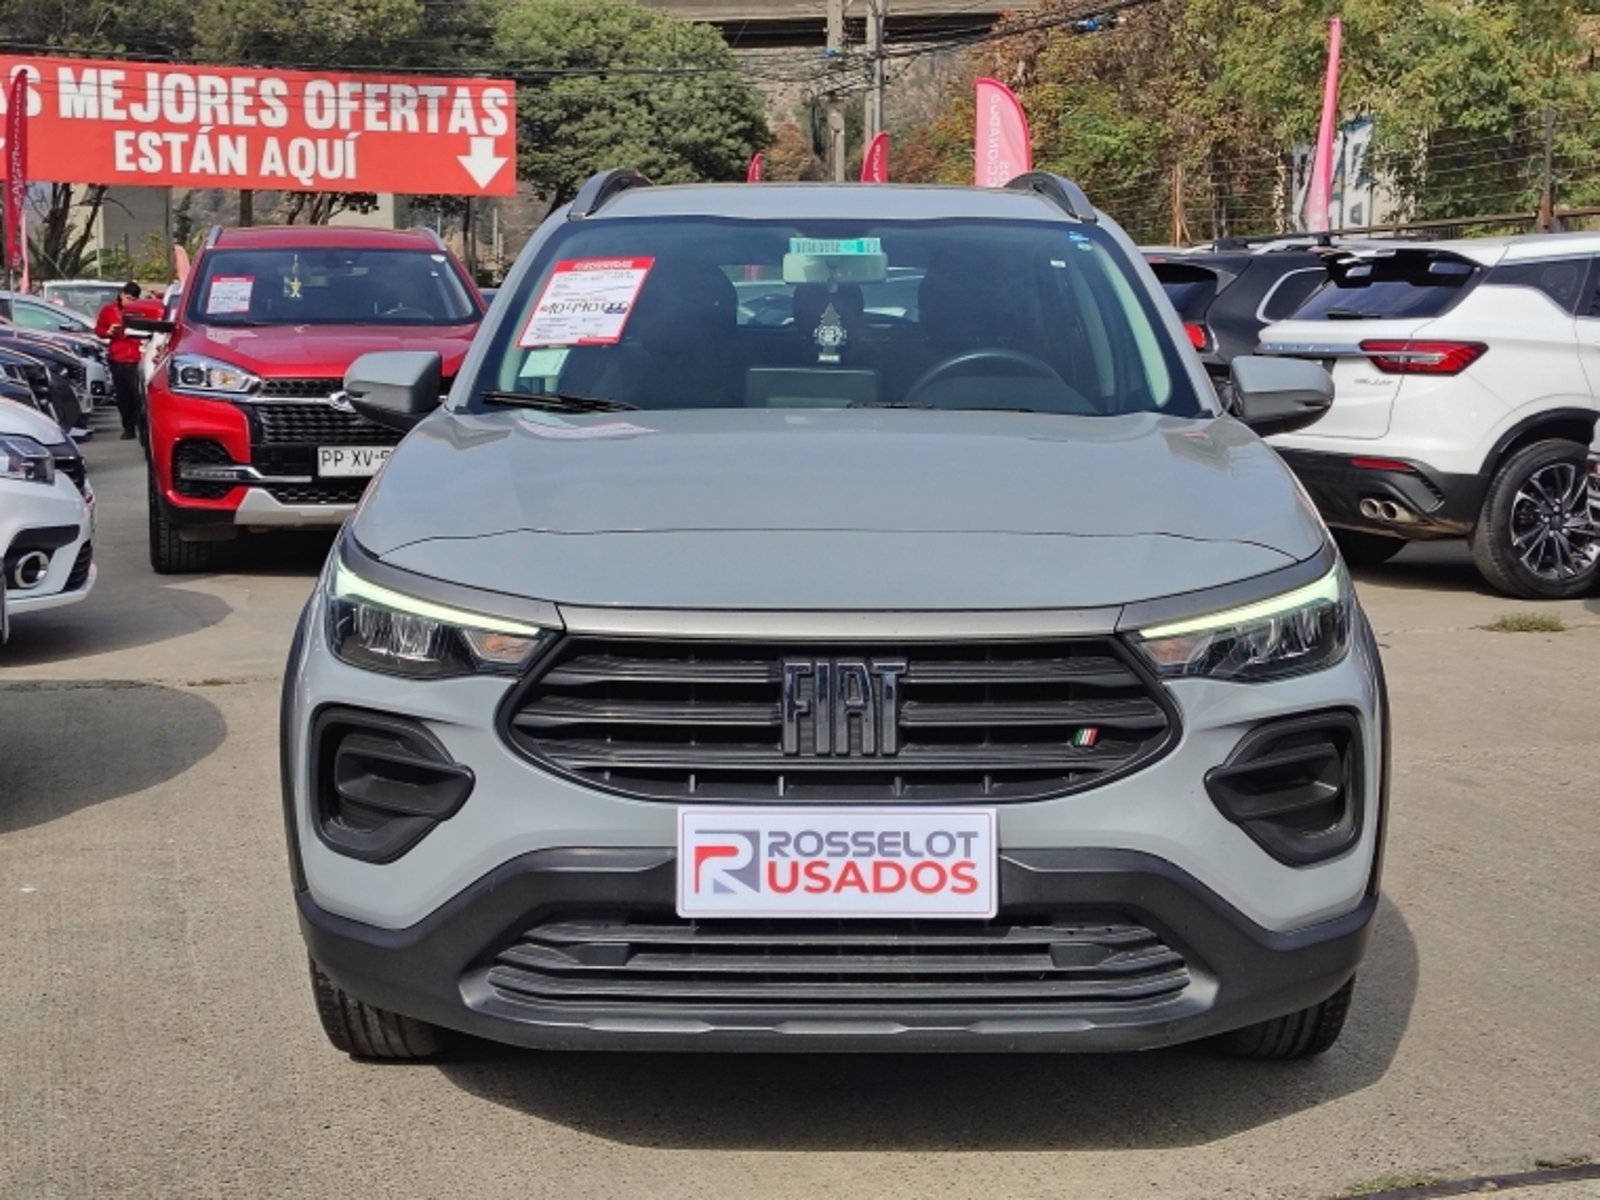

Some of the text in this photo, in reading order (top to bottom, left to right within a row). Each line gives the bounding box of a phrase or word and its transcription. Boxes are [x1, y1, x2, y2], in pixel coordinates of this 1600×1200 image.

[58, 67, 288, 127] MEJORES
[304, 79, 508, 136] OFERTAS
[115, 126, 361, 186] ESTÁN AQUÍ
[783, 658, 907, 755] FIAT
[768, 830, 979, 858] ROSSELOT
[767, 860, 979, 895] USADOS
